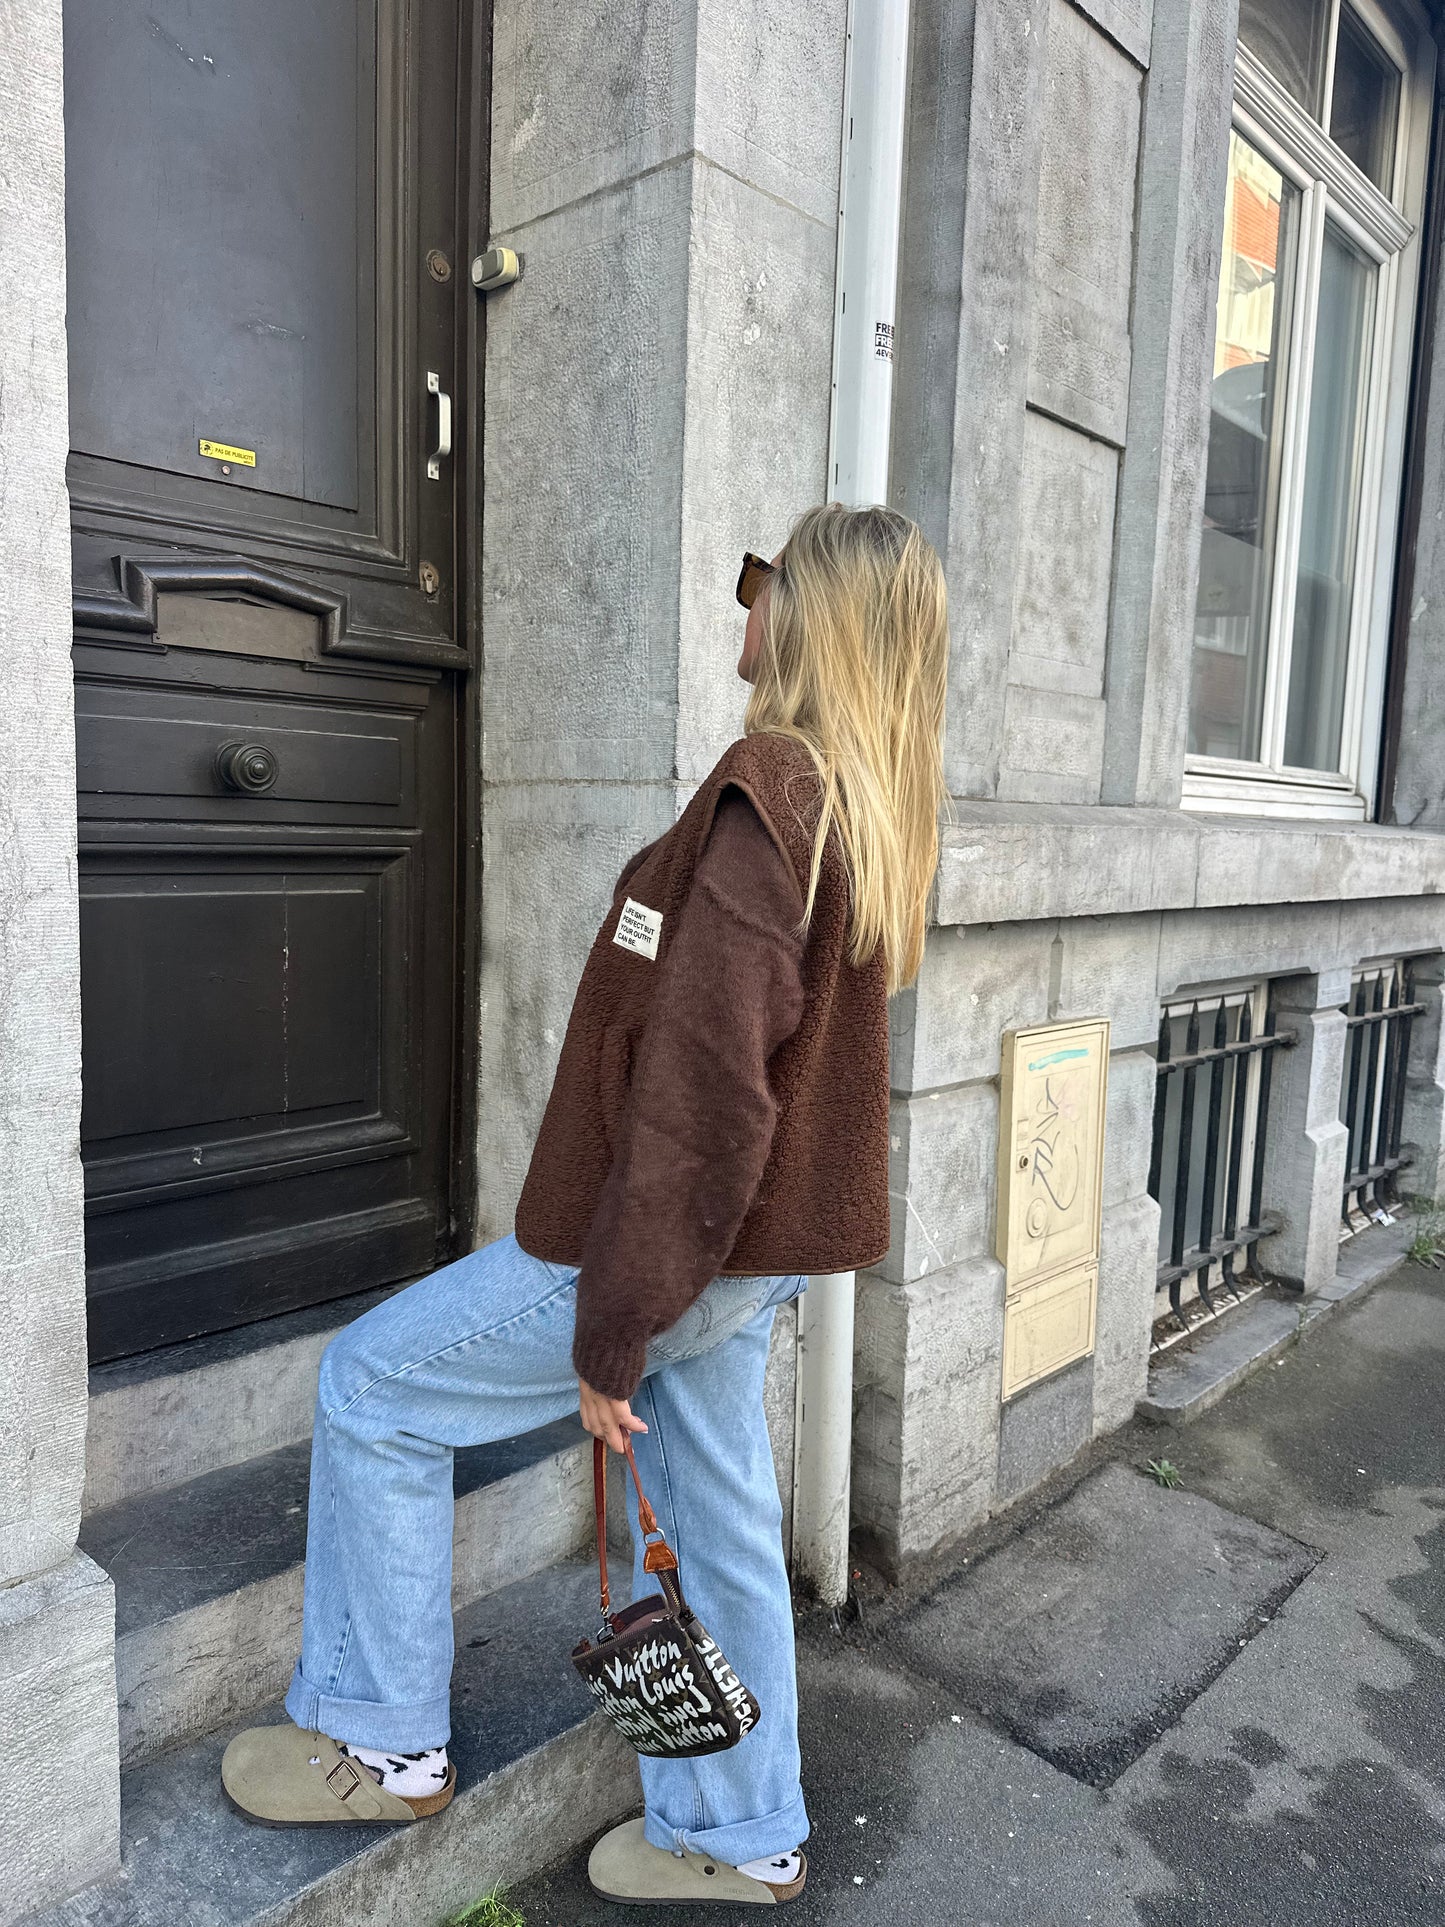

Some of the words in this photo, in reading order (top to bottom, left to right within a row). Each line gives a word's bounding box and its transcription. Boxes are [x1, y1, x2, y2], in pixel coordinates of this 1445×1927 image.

[215, 447, 224, 455] PAS
[625, 906, 635, 916] LIFE
[621, 924, 634, 935] YOUR
[633, 930, 652, 944] OUTFIT
[623, 915, 645, 930] PERFECT
[644, 925, 655, 935] BUT
[618, 932, 628, 943] CAN
[604, 1640, 682, 1690] Vuitton
[639, 1664, 694, 1706] Louis
[653, 1721, 727, 1750] Vuitton
